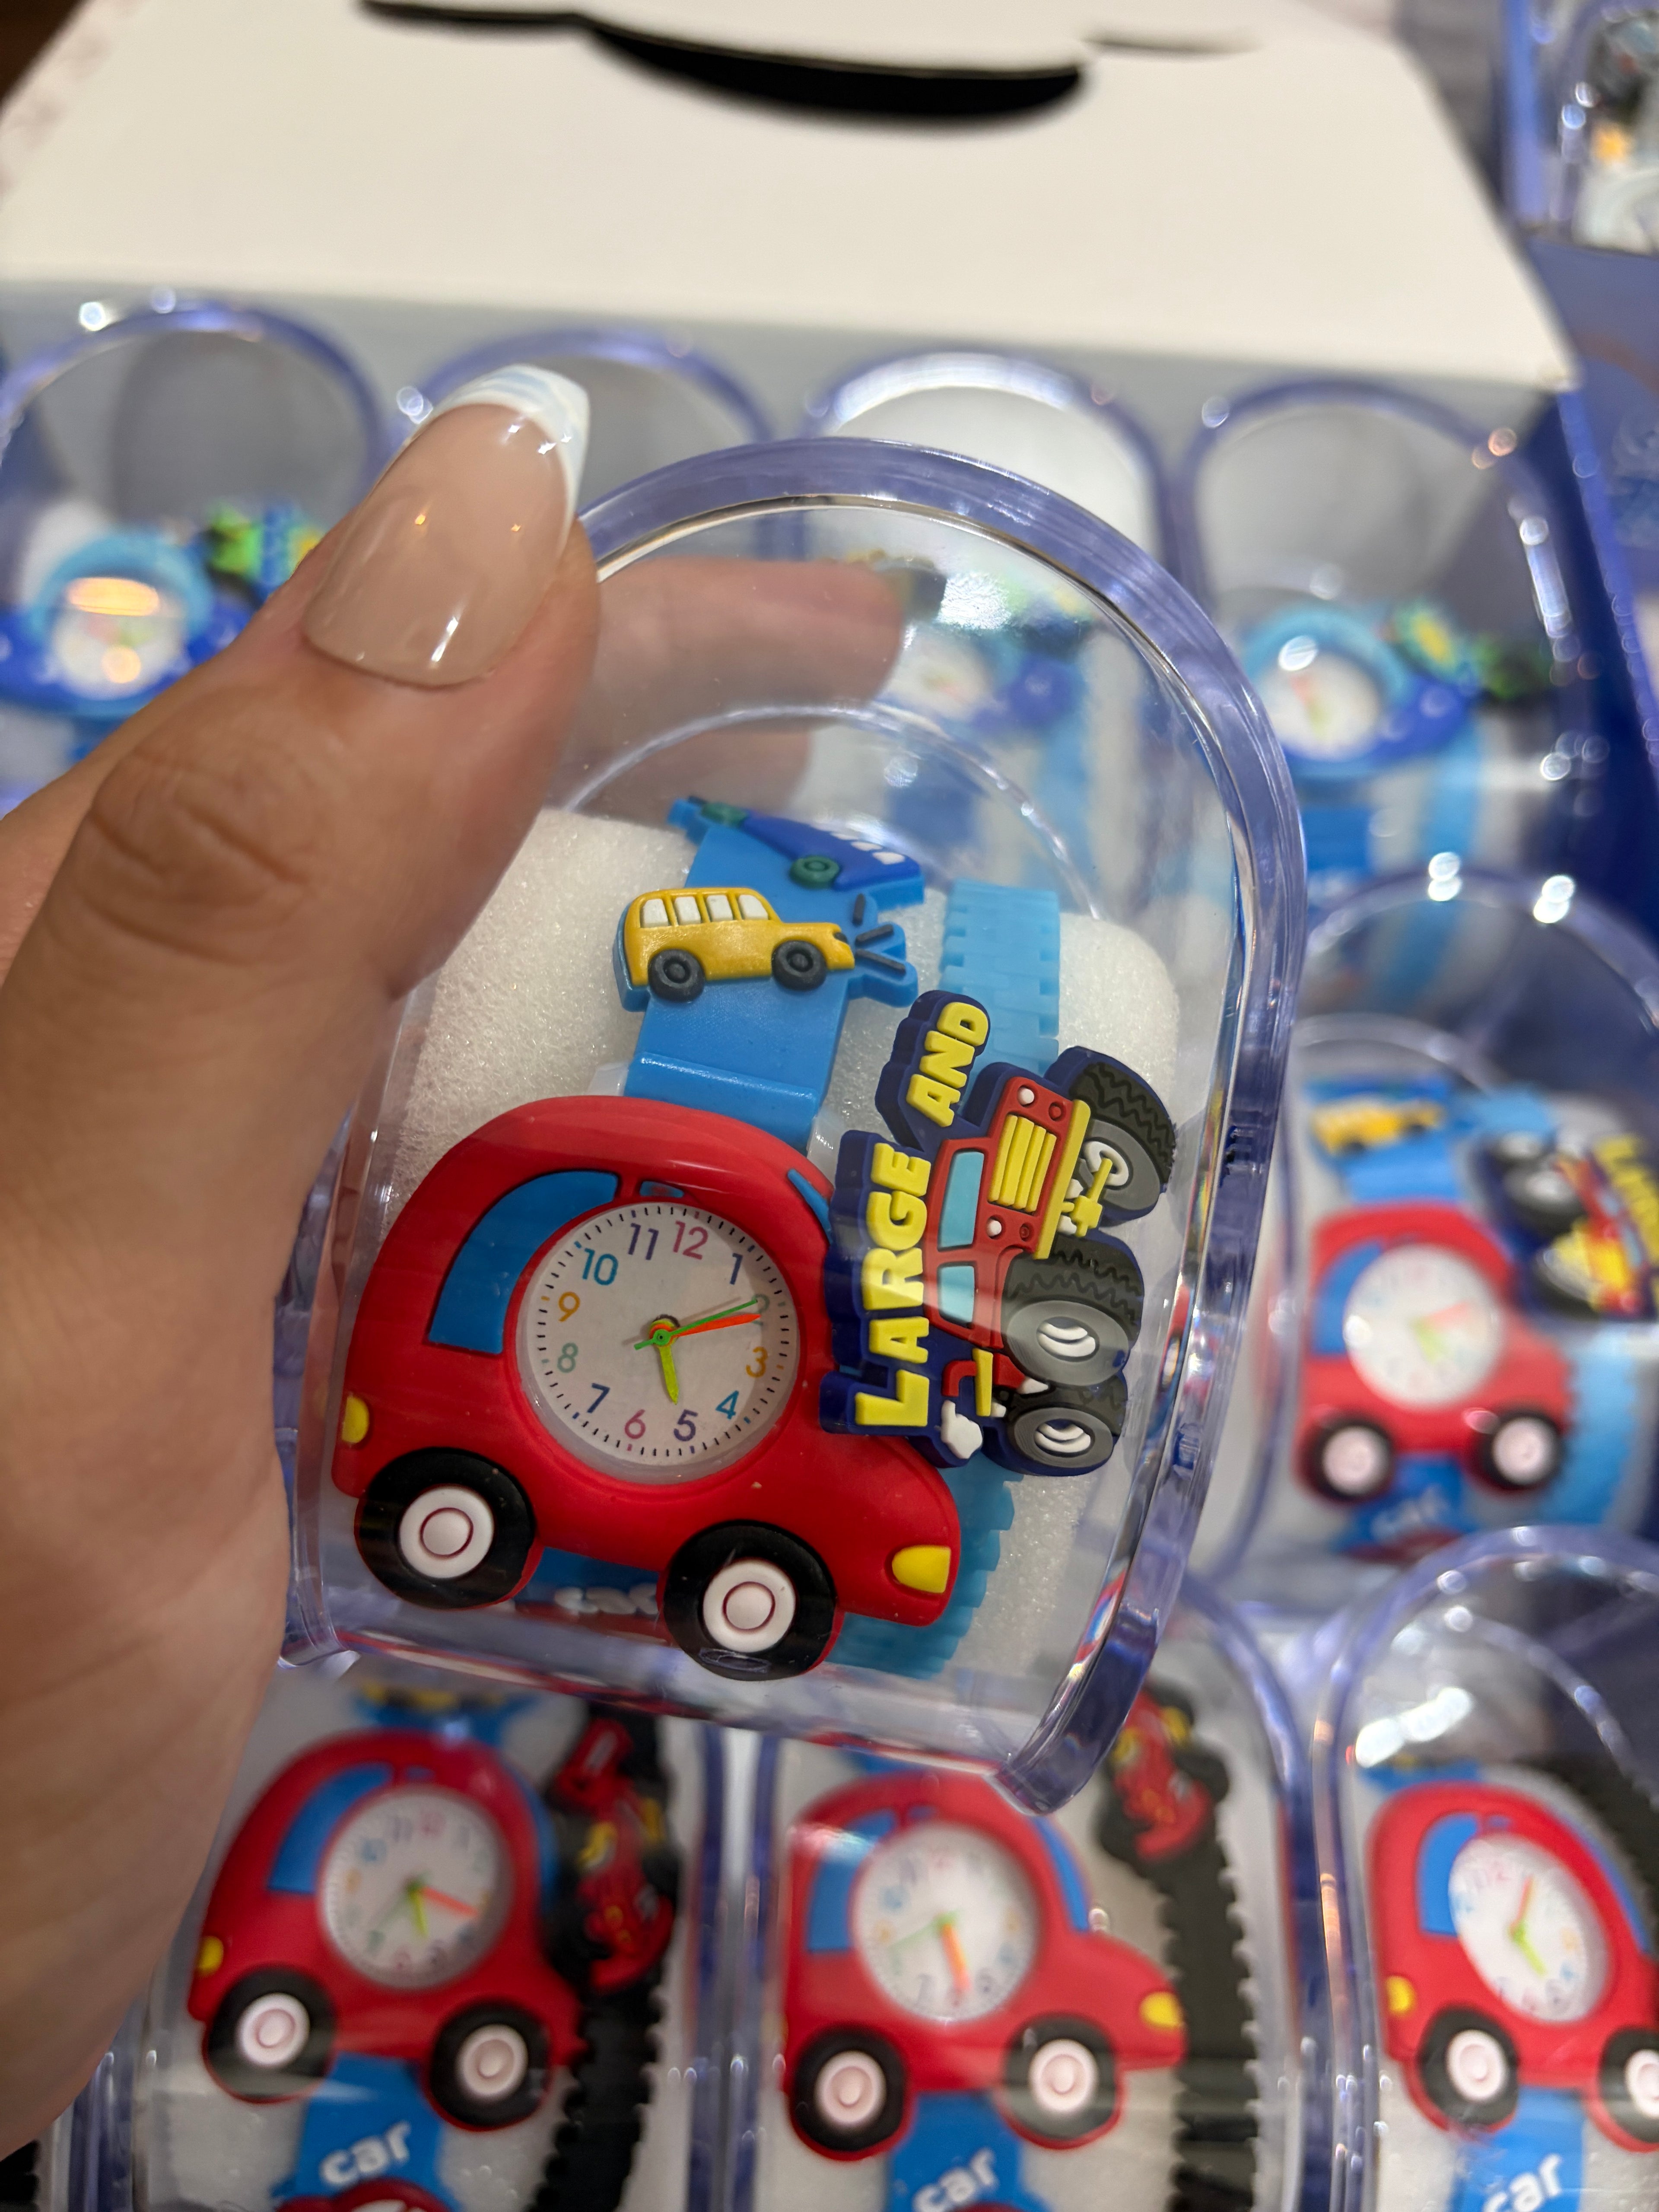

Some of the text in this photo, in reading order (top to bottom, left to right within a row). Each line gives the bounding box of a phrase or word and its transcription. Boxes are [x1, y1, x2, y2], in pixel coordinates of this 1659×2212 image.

[855, 1002, 988, 1427] LARGE AND
[628, 1223, 659, 1260] 11
[673, 1220, 708, 1259] 12
[582, 1248, 619, 1285] 10
[730, 1253, 743, 1284] 1
[559, 1292, 580, 1322] 9
[557, 1343, 578, 1373] 8
[746, 1347, 768, 1377] 3
[587, 1383, 610, 1413] 7
[715, 1390, 739, 1419] 4
[624, 1410, 646, 1440] 6
[674, 1409, 698, 1441] 5
[320, 2120, 411, 2185] car
[912, 2148, 998, 2212] car
